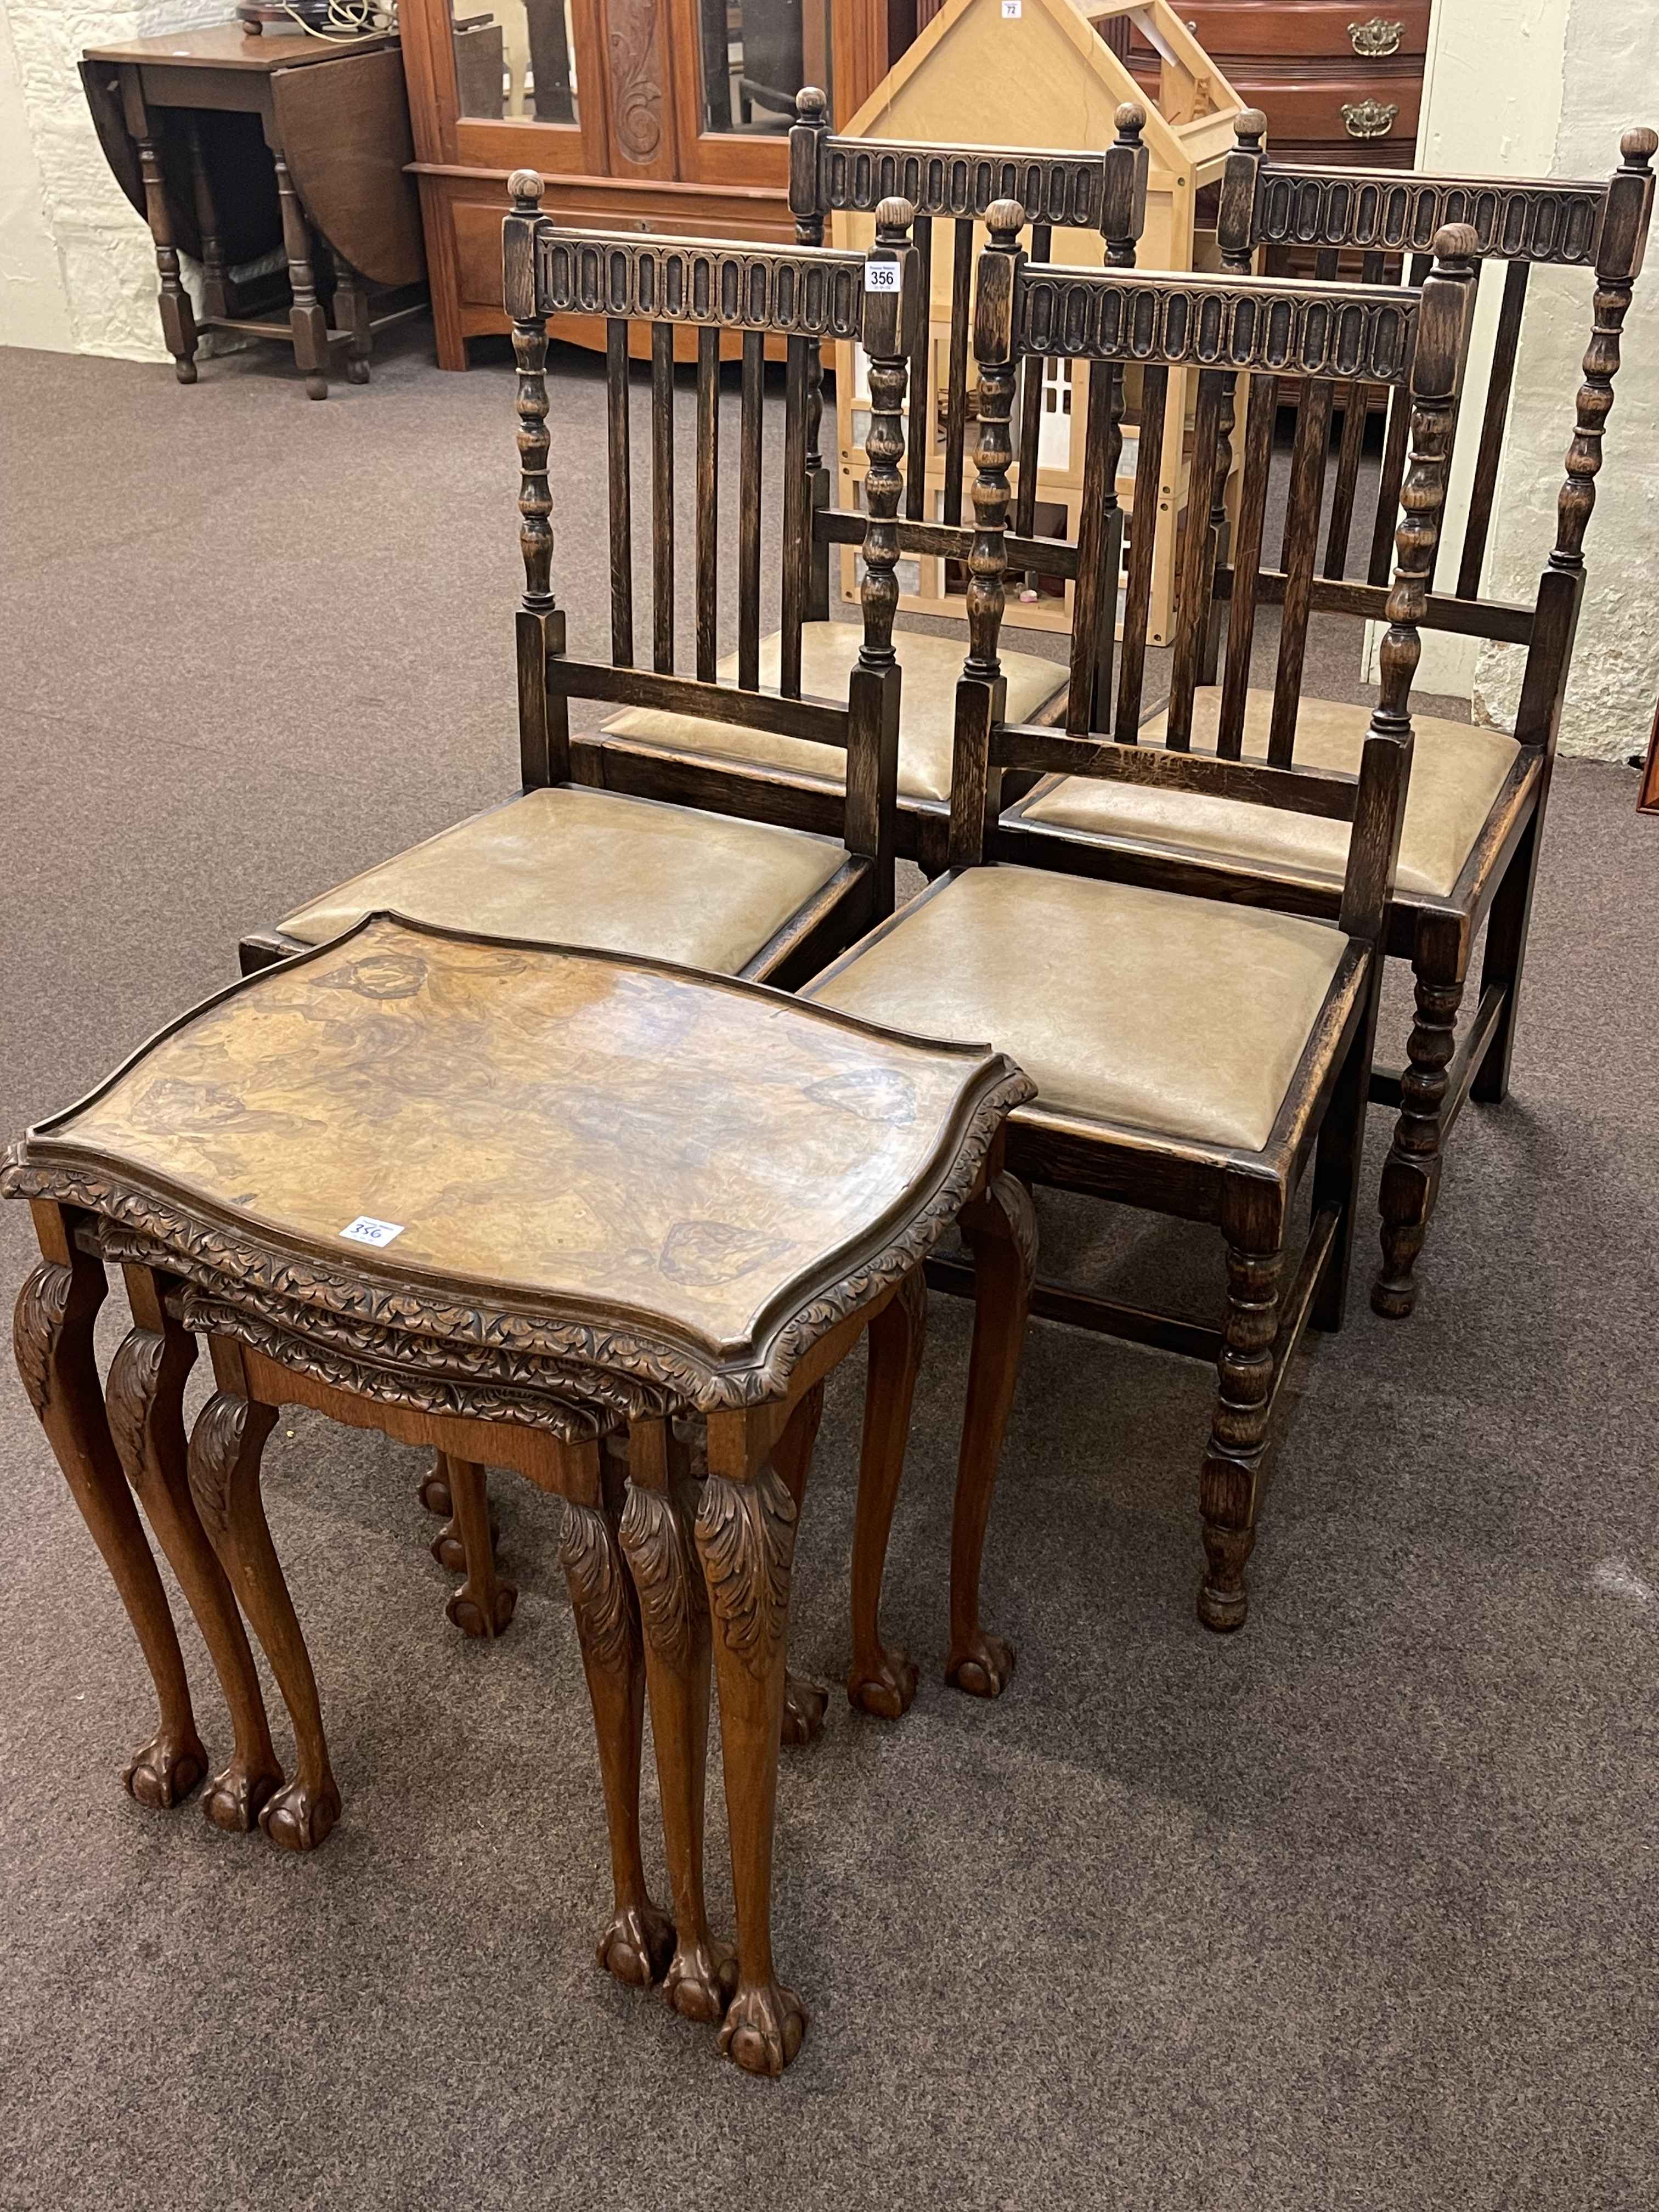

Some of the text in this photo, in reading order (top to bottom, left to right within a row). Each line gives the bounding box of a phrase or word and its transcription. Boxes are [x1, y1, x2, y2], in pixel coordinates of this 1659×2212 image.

[1007, 5, 1015, 14] 72
[871, 271, 894, 285] 356
[349, 1223, 382, 1238] 356
